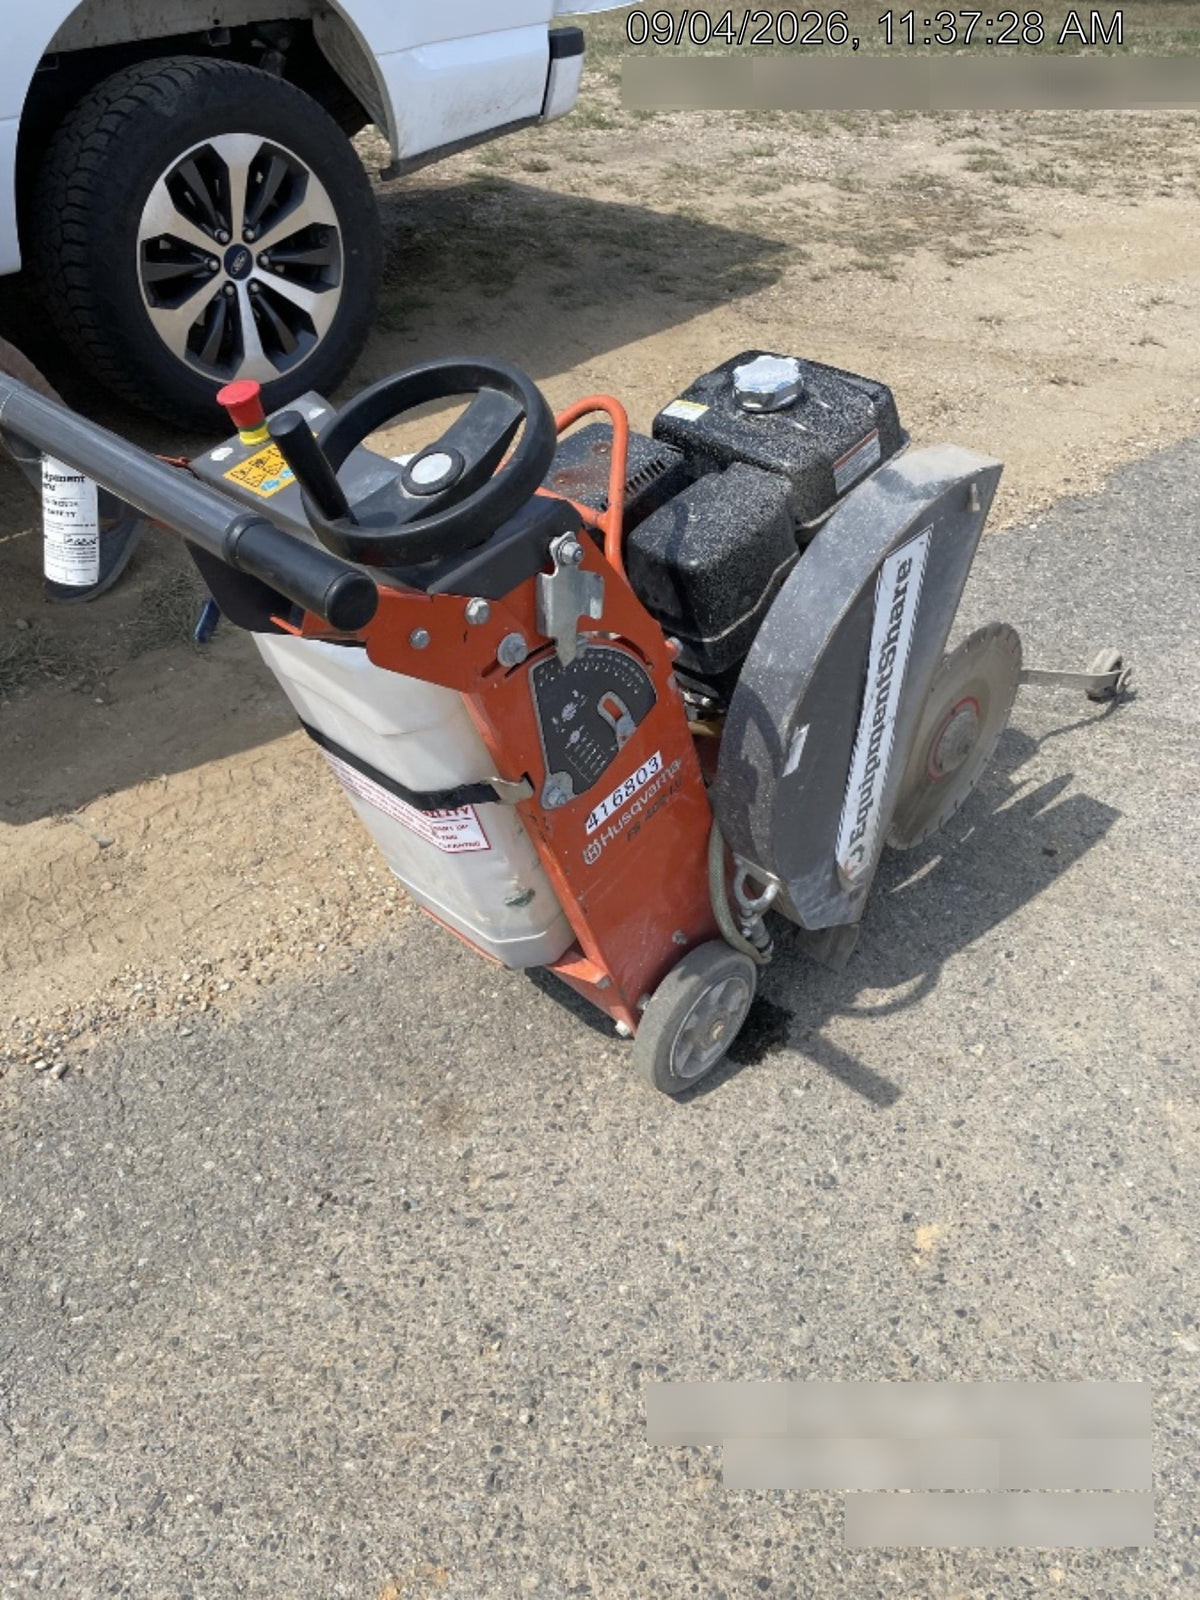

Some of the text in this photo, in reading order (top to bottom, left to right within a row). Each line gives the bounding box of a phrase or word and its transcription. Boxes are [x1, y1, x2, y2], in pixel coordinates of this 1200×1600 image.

[850, 556, 913, 844] EquipmentShare
[585, 756, 659, 830] 416803
[600, 758, 682, 848] Husqvarna
